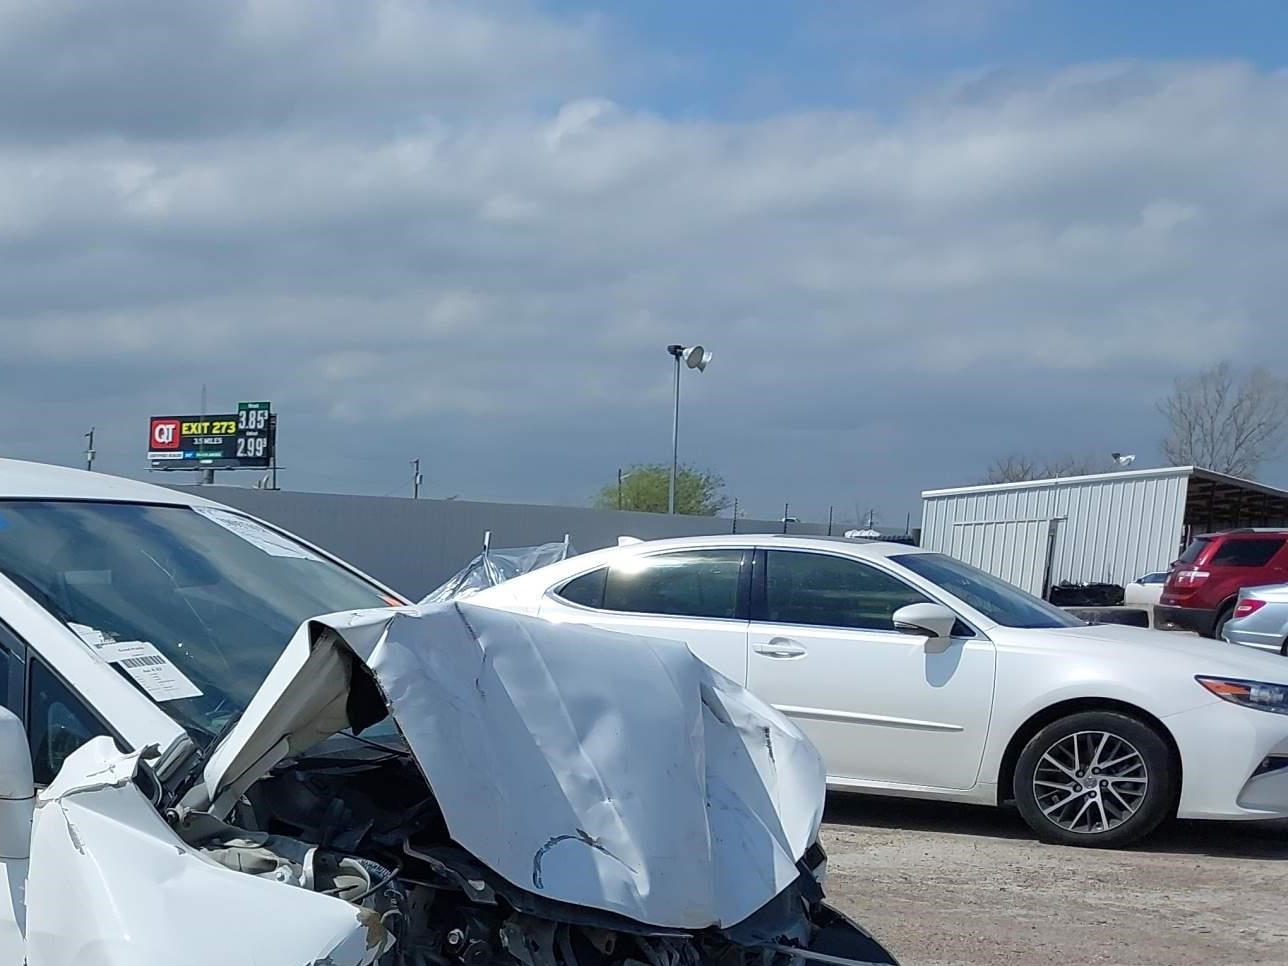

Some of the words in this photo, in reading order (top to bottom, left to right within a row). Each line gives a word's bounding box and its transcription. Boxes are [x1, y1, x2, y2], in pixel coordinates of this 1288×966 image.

[154, 424, 175, 443] QT
[182, 422, 210, 435] EXIT
[212, 421, 236, 434] 273
